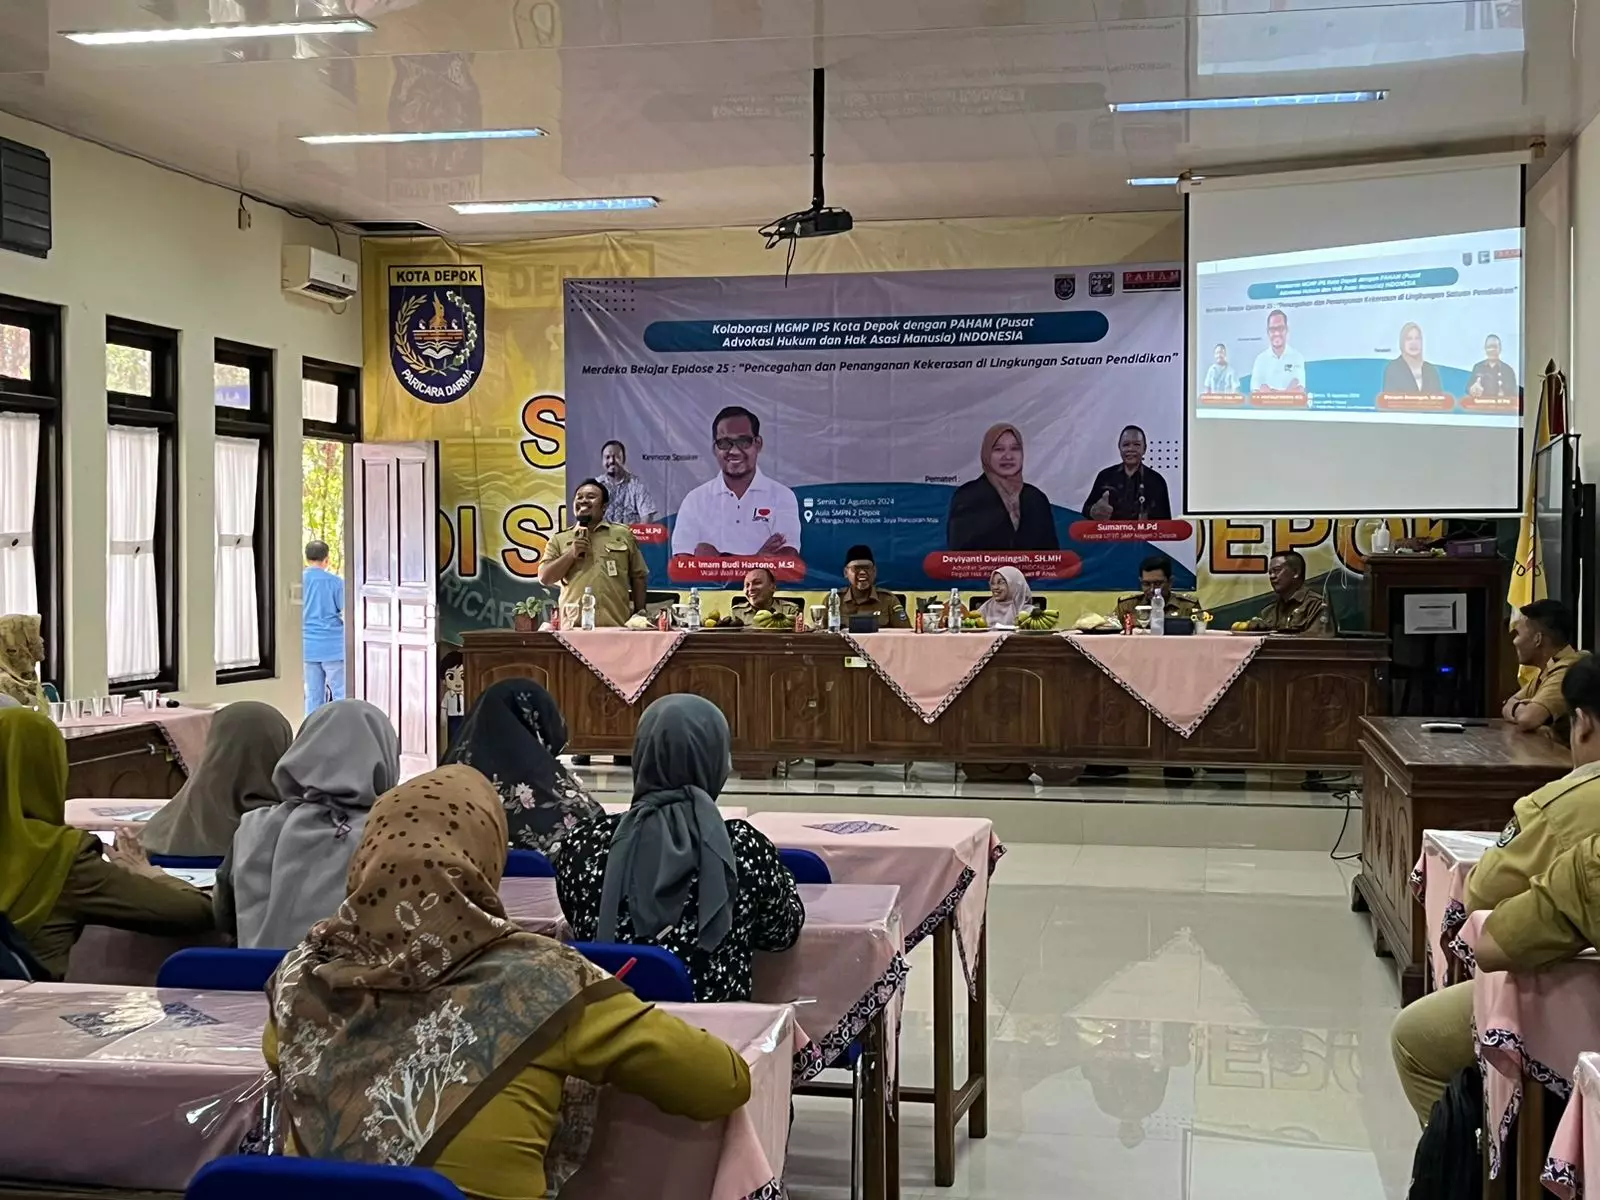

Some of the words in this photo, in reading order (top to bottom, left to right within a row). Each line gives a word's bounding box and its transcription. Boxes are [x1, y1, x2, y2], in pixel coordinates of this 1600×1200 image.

[396, 271, 431, 282] KOTA
[434, 270, 478, 282] DEPOK
[712, 322, 772, 334] Kolaborasi
[774, 322, 810, 333] MGMP
[811, 321, 830, 332] IPS
[832, 321, 861, 332] Kota
[863, 320, 901, 333] Depok
[902, 319, 947, 332] dengan
[950, 318, 993, 329] PAHAM
[995, 317, 1035, 329] (Pusat
[722, 336, 774, 347] Advokasi
[776, 335, 817, 346] Hukum
[819, 335, 842, 346] dan
[844, 334, 867, 345] Hak
[869, 333, 901, 344] Asasi
[902, 332, 956, 344] Manusia)
[958, 331, 1024, 342] INDONESIA
[581, 364, 628, 375] Merdeka
[630, 364, 669, 376] Belajar
[671, 363, 714, 376] Epidose
[715, 363, 729, 373] 25
[739, 361, 812, 374] "Pencegahan
[814, 360, 836, 371] dan
[838, 359, 910, 373] Penanganan
[913, 359, 973, 370] Kekerasan
[975, 357, 988, 368] di
[990, 356, 1057, 369] Lingkungan
[1060, 355, 1103, 366] Satuan
[1105, 352, 1179, 365] Pendidikan"
[401, 368, 445, 397] PARICARA
[445, 369, 475, 396] DARMA
[858, 509, 881, 517] Depok
[1097, 523, 1136, 532] Sumarno,
[1137, 522, 1158, 531] M.Pd
[698, 561, 720, 569] Imam
[721, 560, 740, 569] Budi
[741, 560, 777, 569] Hartono,
[778, 560, 795, 569] M.Si
[942, 555, 983, 564] Deviyanti
[984, 554, 1032, 564] Dwiningsih,
